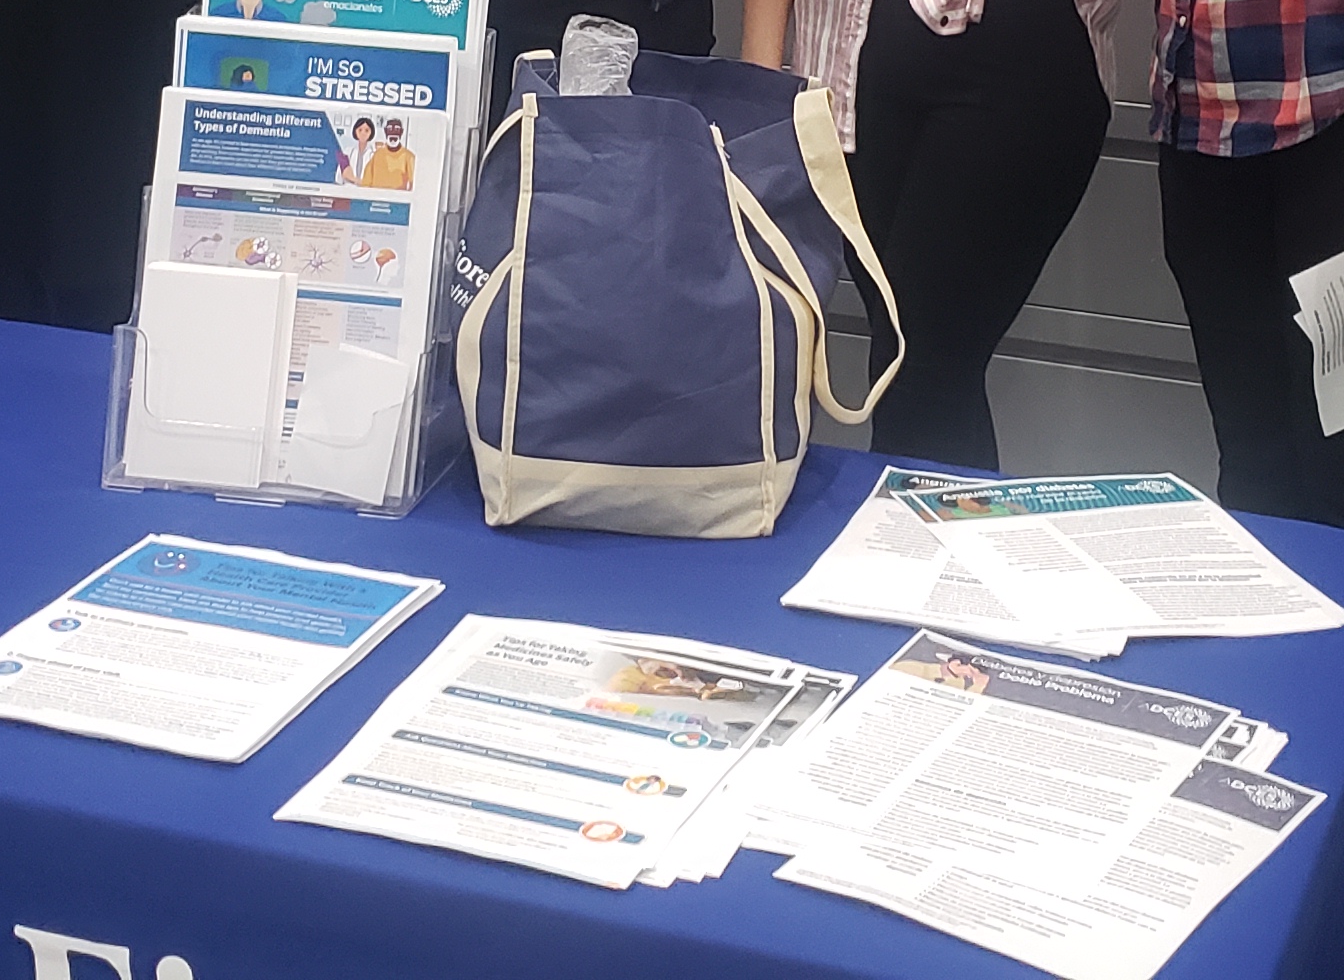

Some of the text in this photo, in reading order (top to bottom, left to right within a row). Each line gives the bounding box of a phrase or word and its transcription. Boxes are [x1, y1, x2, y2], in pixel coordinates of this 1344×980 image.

[323, 0, 383, 13] emocionales
[338, 59, 364, 78] SO
[305, 78, 434, 108] STRESSED
[194, 107, 322, 129] Understanding Different
[192, 120, 291, 139] Types of Dementia
[941, 488, 1004, 502] Angustia
[1008, 486, 1033, 497] por
[1035, 482, 1095, 494] diabetes
[200, 576, 245, 588] About
[247, 582, 276, 594] Your
[279, 587, 328, 604] Mental
[207, 569, 349, 598] Health Care Provider
[493, 642, 593, 667] Medicines Safely
[503, 635, 588, 658] Tips for Taking
[502, 651, 524, 662] You
[524, 657, 549, 667] Age
[971, 656, 1034, 676] Diabetes
[998, 671, 1116, 705] Doble Problema
